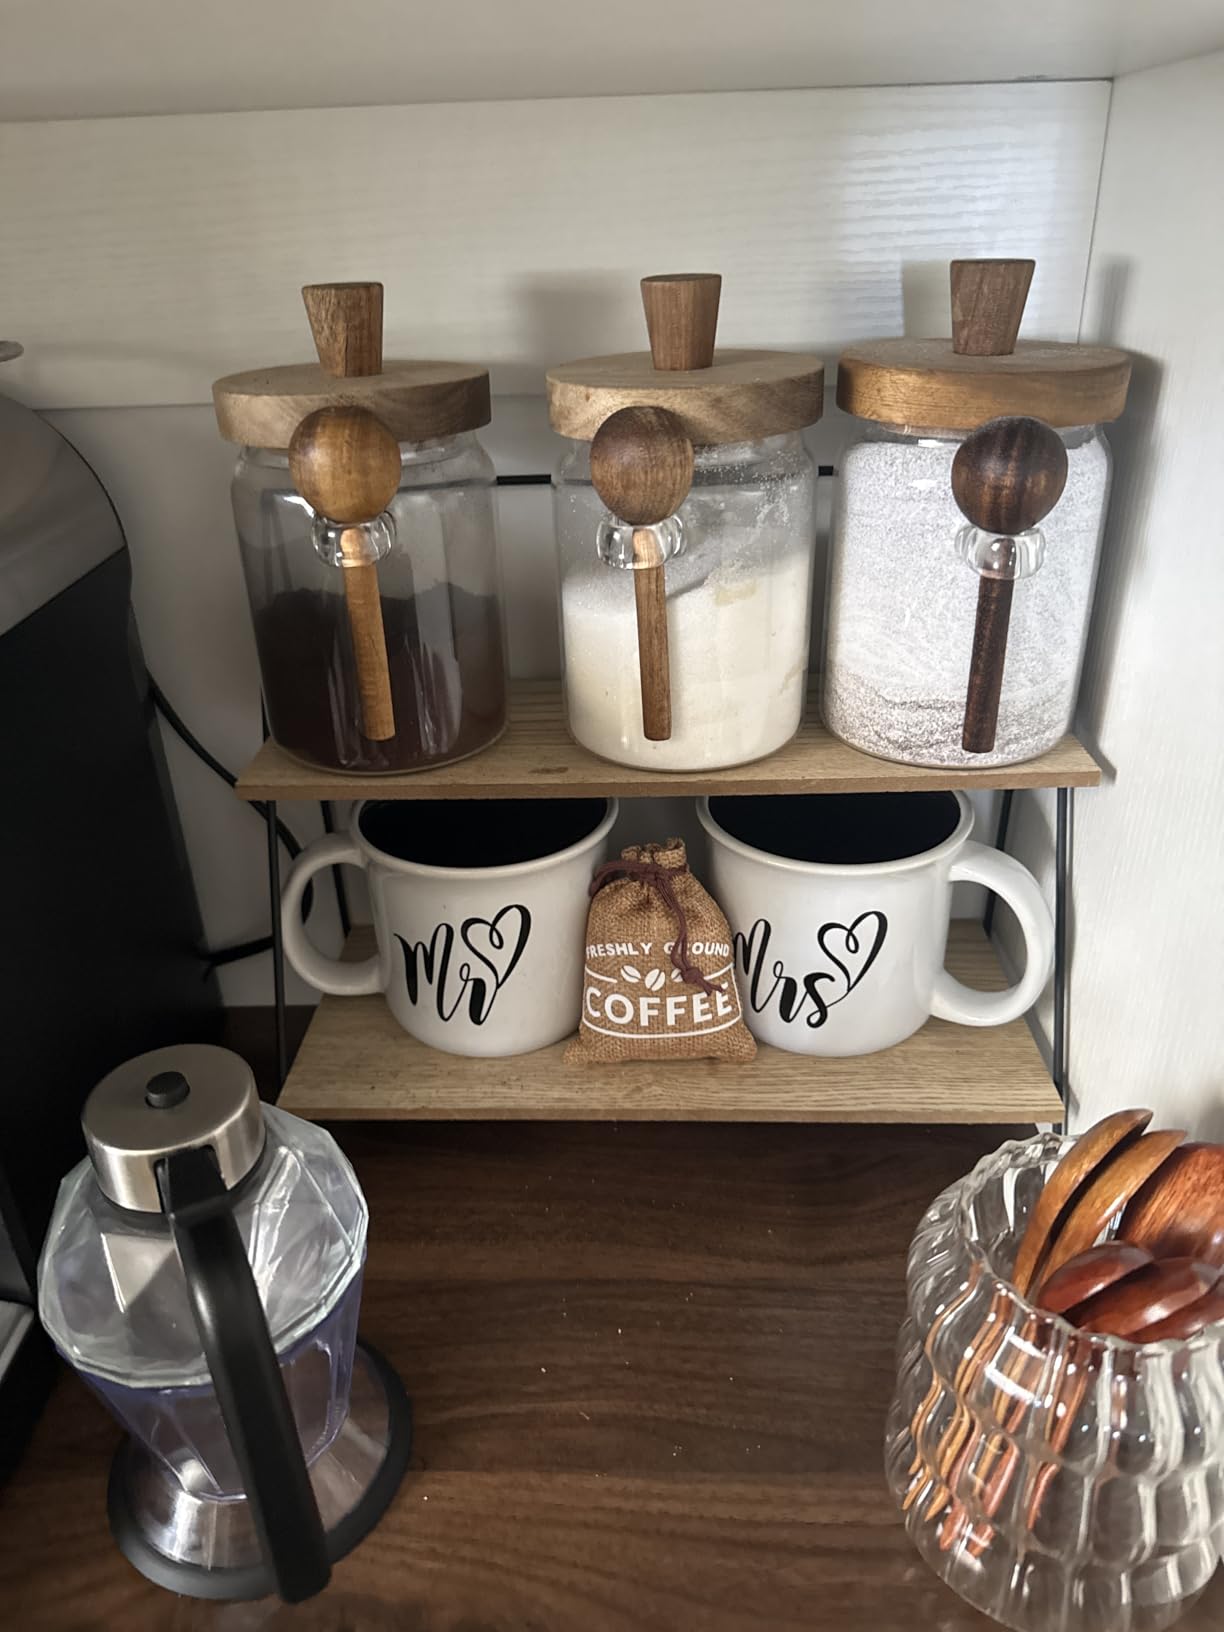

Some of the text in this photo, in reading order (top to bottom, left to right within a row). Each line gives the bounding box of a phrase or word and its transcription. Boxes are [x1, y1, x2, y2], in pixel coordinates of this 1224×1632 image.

[585, 942, 730, 959] FRESHLY GOUND
[393, 922, 498, 1026] Mr
[585, 982, 732, 1027] COFFEE
